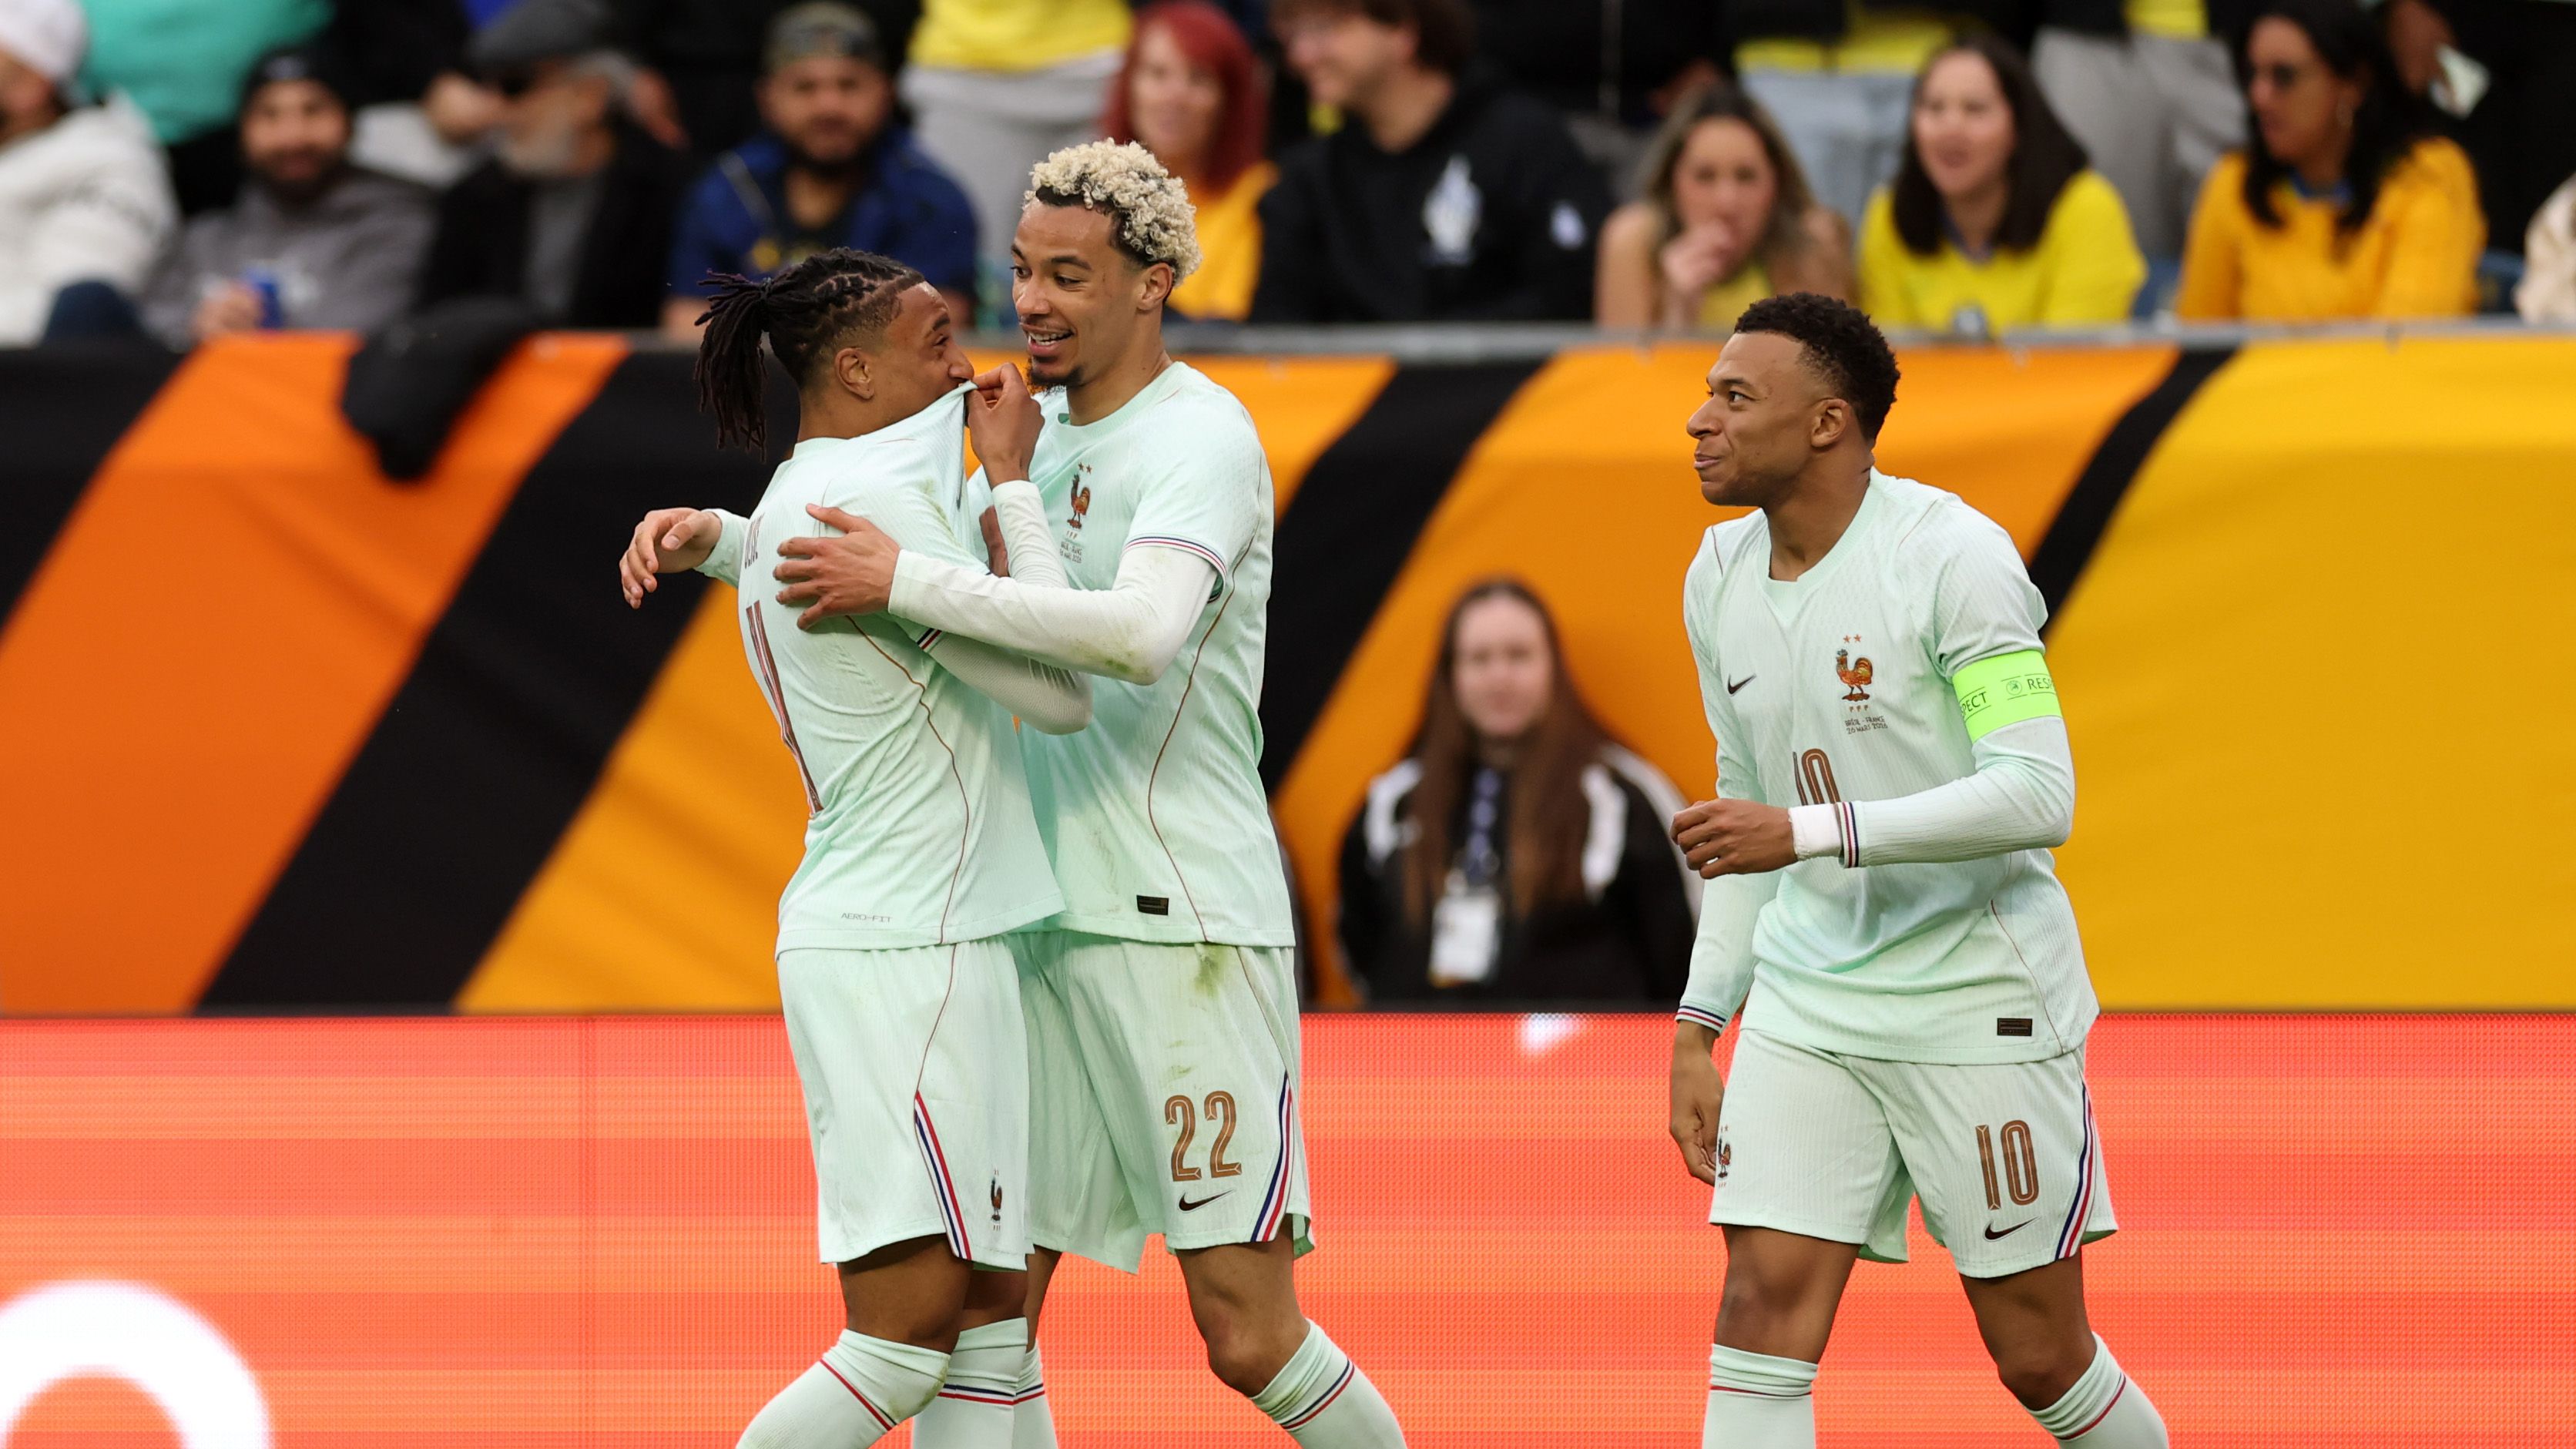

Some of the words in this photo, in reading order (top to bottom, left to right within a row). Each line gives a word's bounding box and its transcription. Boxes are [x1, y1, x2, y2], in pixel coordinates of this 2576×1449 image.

[1792, 748, 1842, 807] 10
[840, 912, 893, 923] AERO-FIT
[1164, 1090, 1243, 1182] 22
[1975, 1119, 2040, 1211] 10
